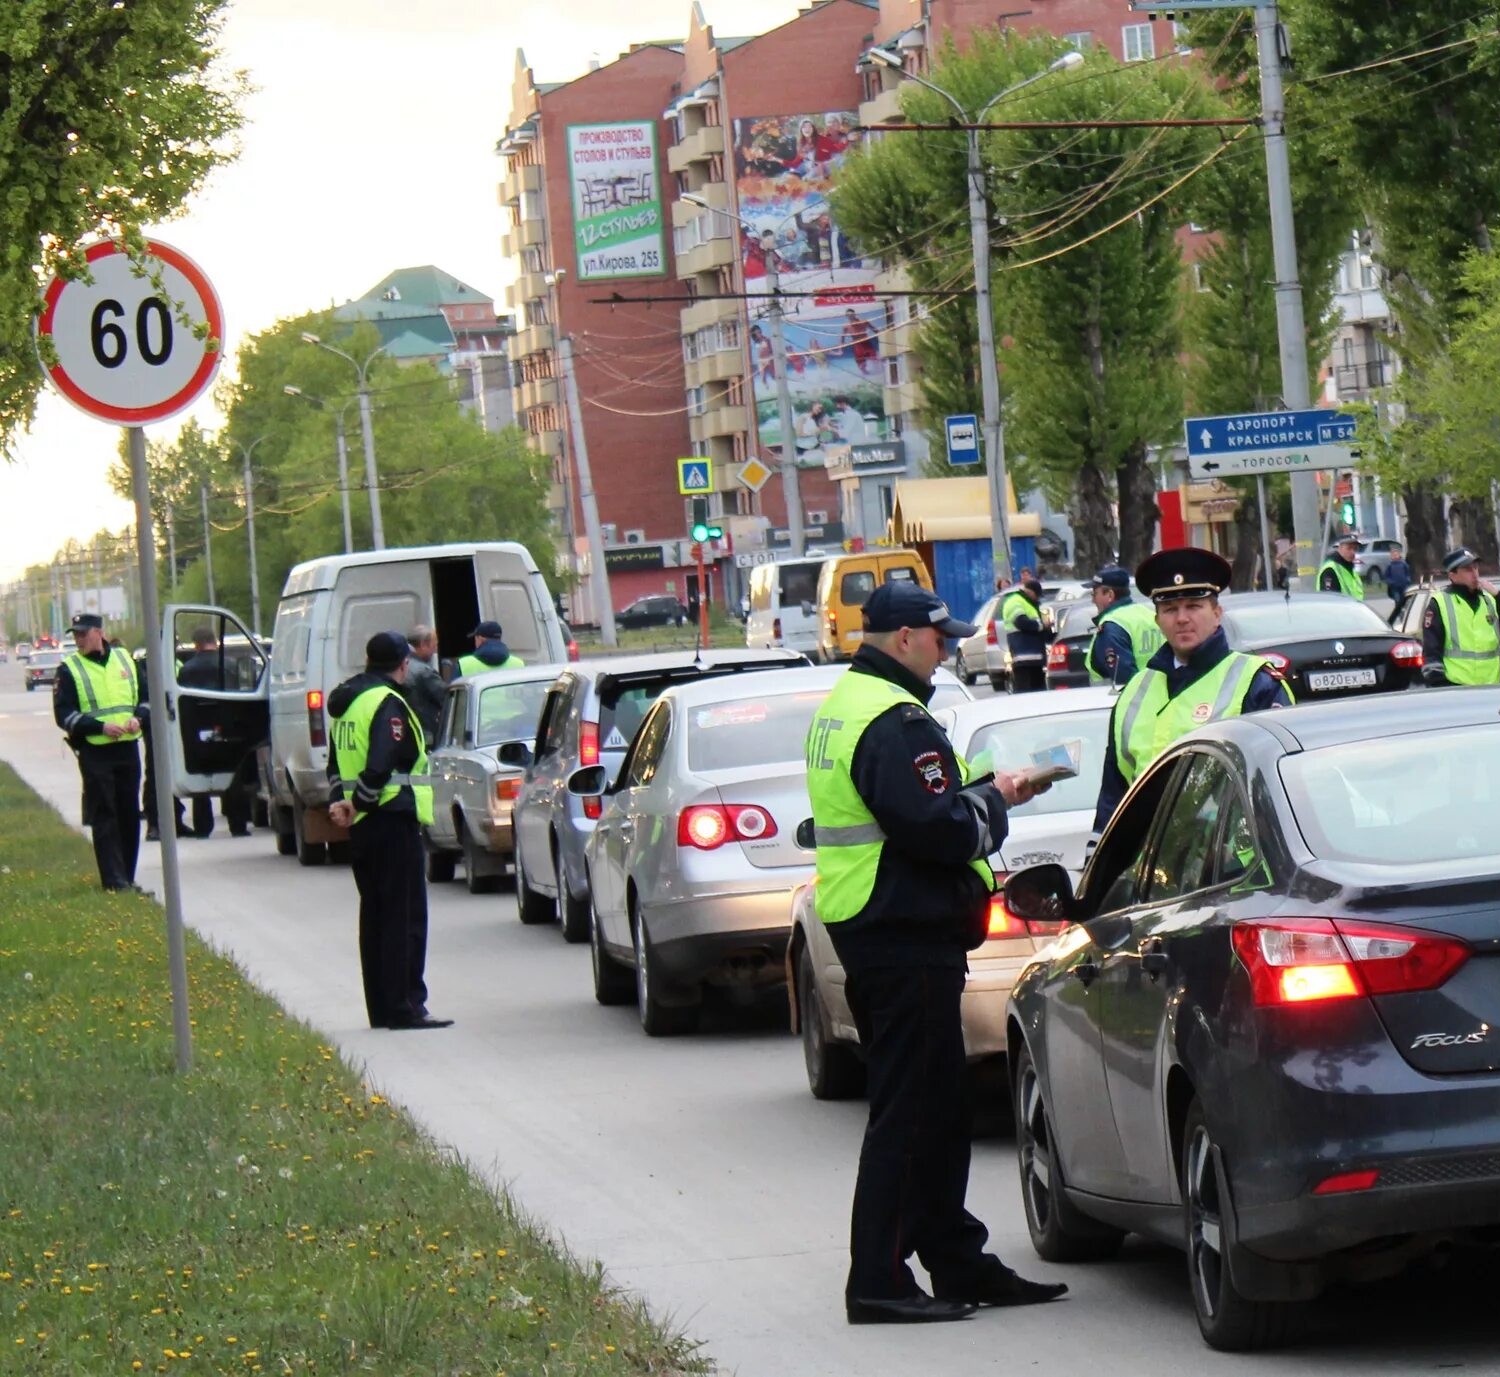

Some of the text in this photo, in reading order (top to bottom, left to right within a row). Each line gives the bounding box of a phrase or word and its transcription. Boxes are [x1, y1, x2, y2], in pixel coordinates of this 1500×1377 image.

[578, 128, 644, 146] ПРОИЗВОДСТВО
[574, 146, 651, 163] СТОЛОВ И СТУЛЬЕВ
[641, 250, 659, 268] 255
[91, 297, 174, 369] 60
[1227, 416, 1296, 432] АЭРОПОРТ
[1228, 426, 1354, 447] КРАСНОЯРСК М 54
